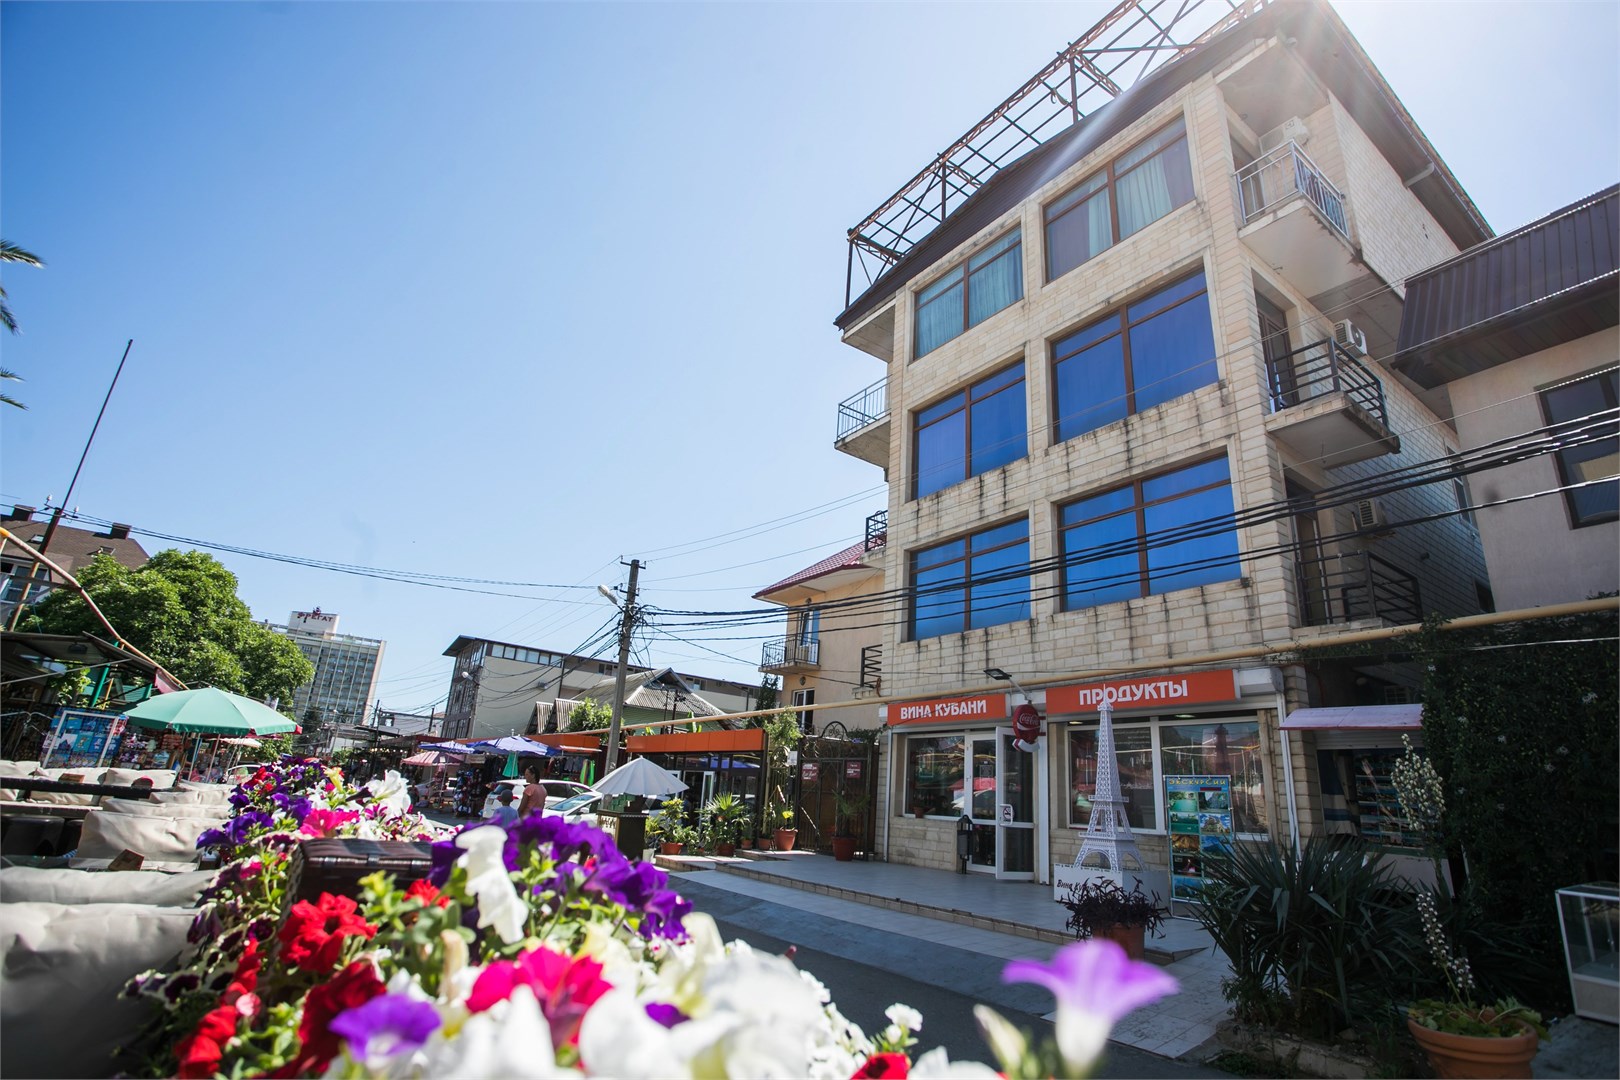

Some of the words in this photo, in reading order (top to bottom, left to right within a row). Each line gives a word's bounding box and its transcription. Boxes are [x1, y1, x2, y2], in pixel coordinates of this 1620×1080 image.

[297, 612, 333, 622] ФРЕГАТ
[1079, 680, 1188, 705] ПРОДУКТЫ
[900, 704, 932, 720] ВИНА
[935, 700, 987, 717] КУБАНИ
